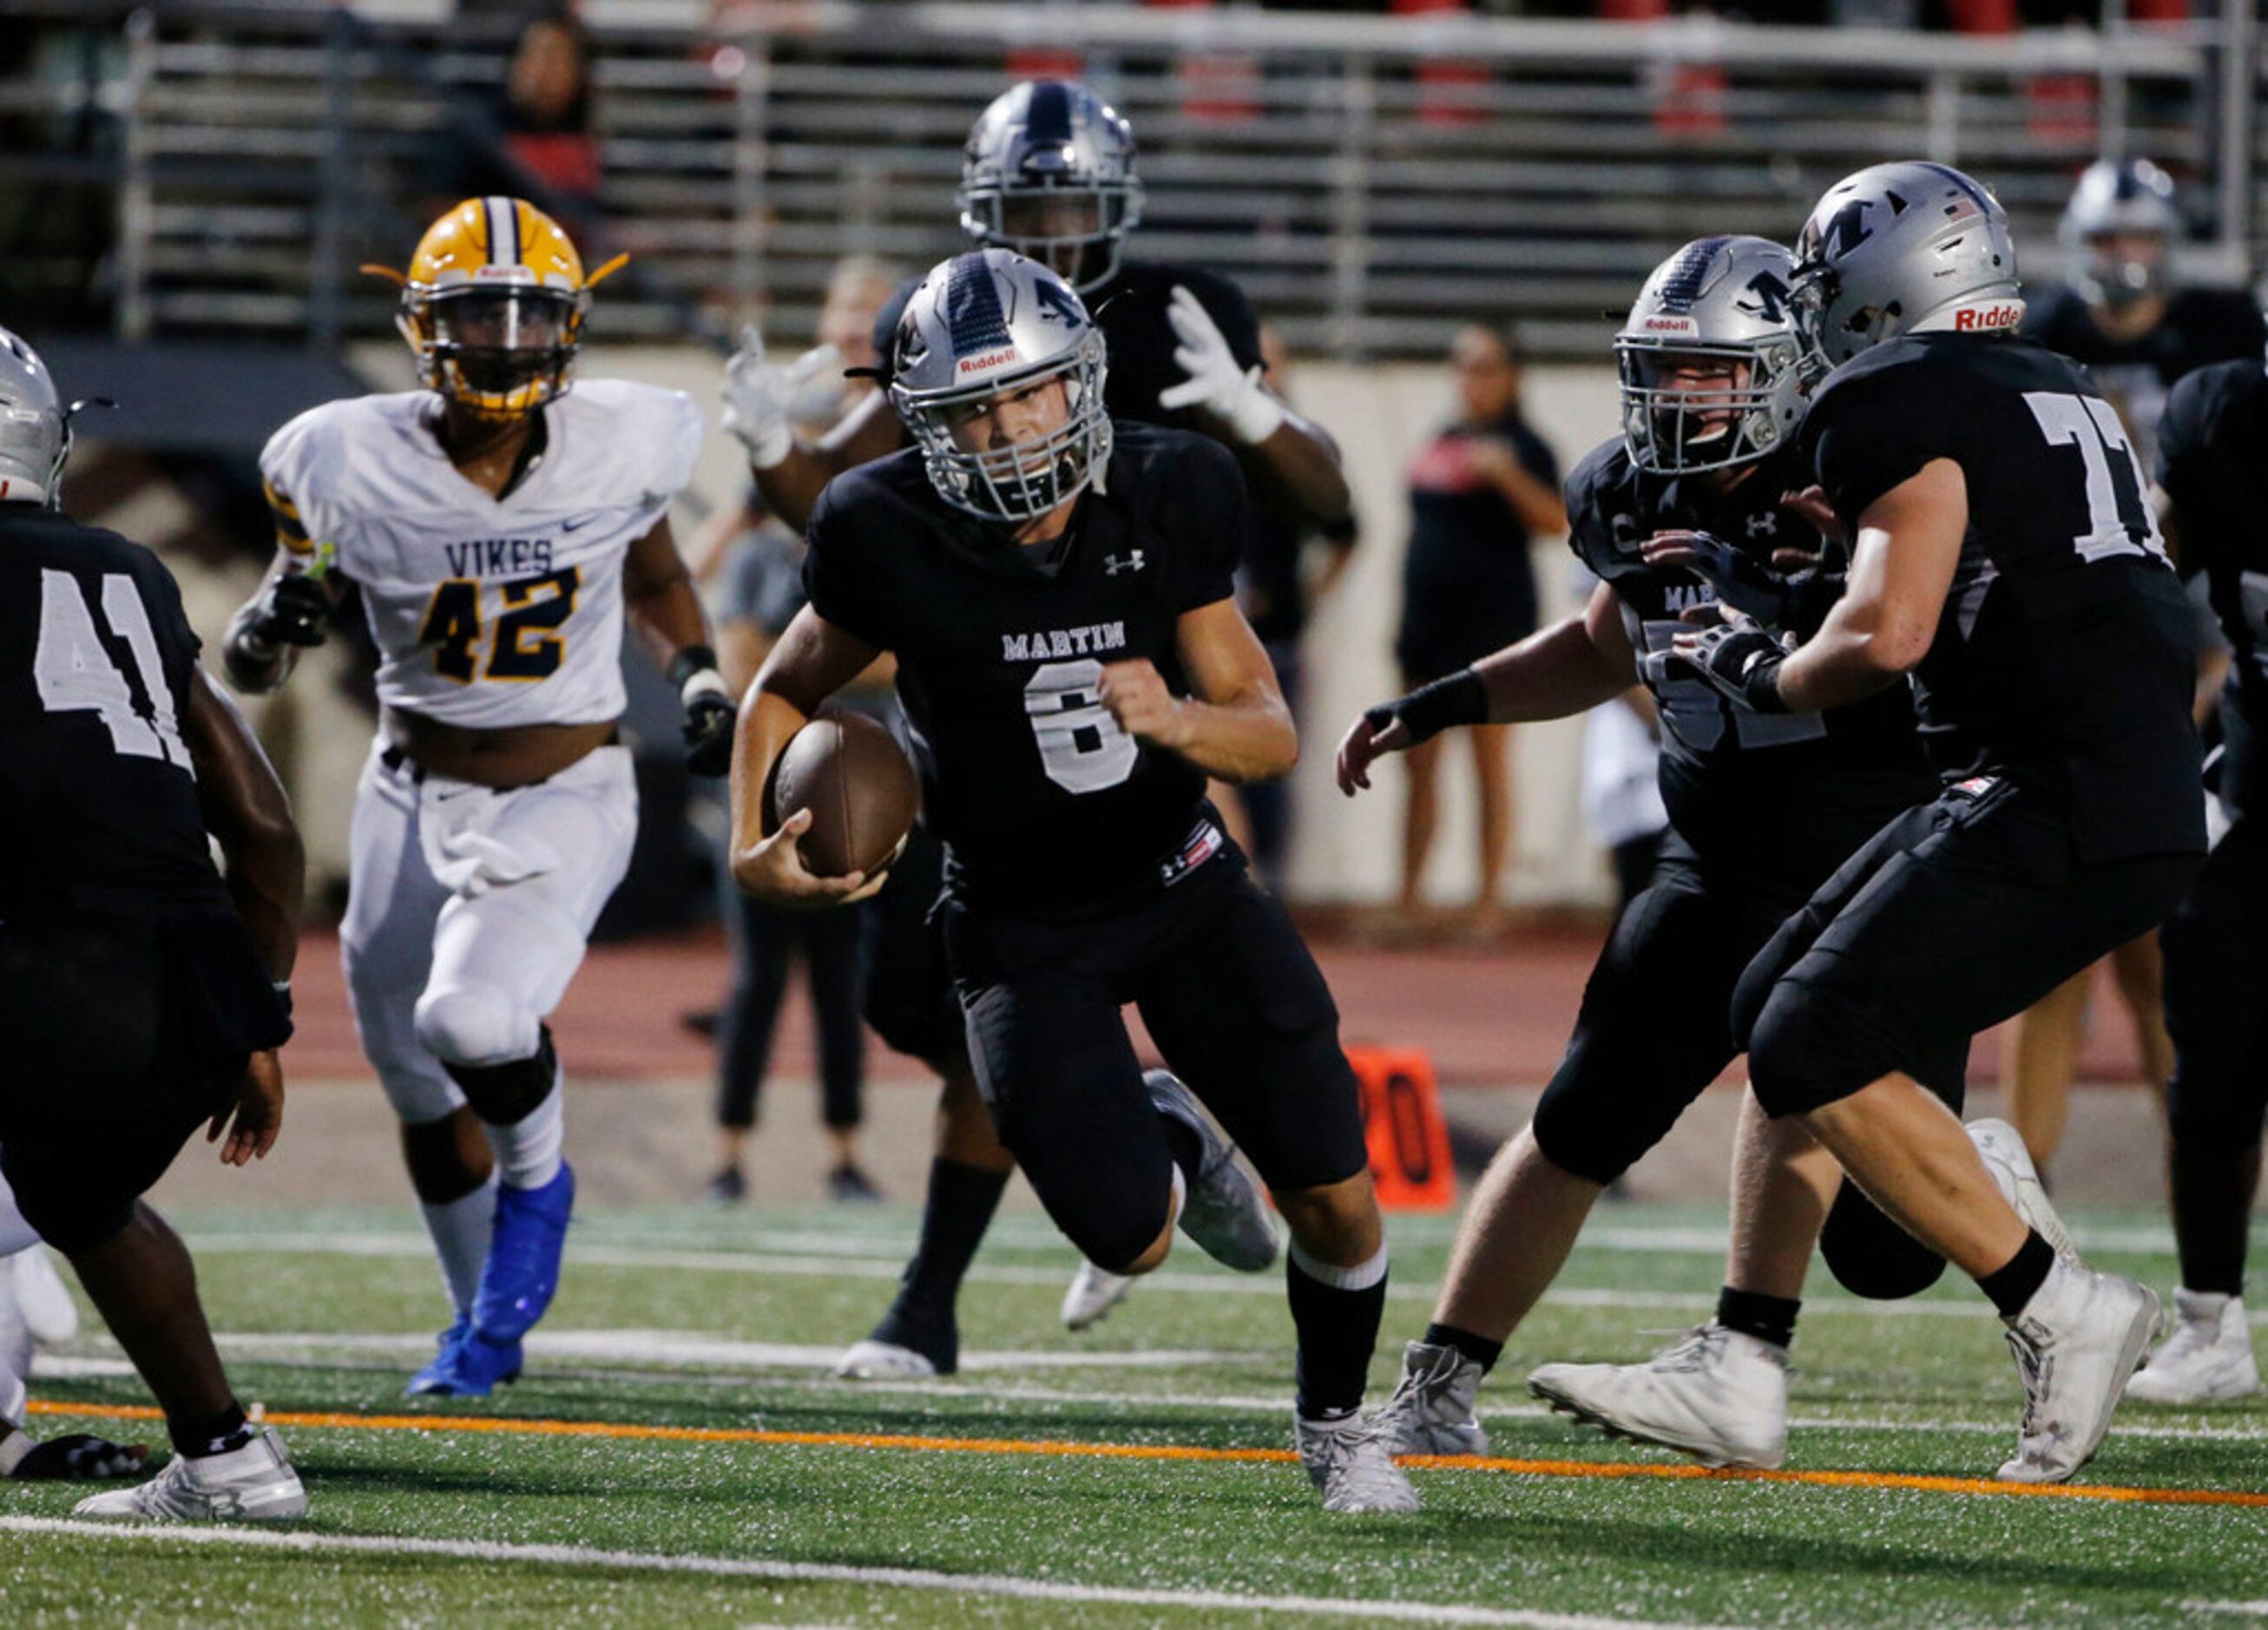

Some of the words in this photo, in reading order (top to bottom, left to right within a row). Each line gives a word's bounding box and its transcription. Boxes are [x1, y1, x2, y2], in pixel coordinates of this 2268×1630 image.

[960, 349, 1015, 373] Riddell
[1646, 319, 1689, 331] Riddell
[2021, 391, 2176, 571] 77
[444, 539, 553, 579] VIKES
[33, 568, 197, 783] 41
[417, 562, 583, 684] 42
[1002, 621, 1127, 661] MARTIN
[1023, 658, 1140, 796] 6
[1358, 1072, 1432, 1186] 0
